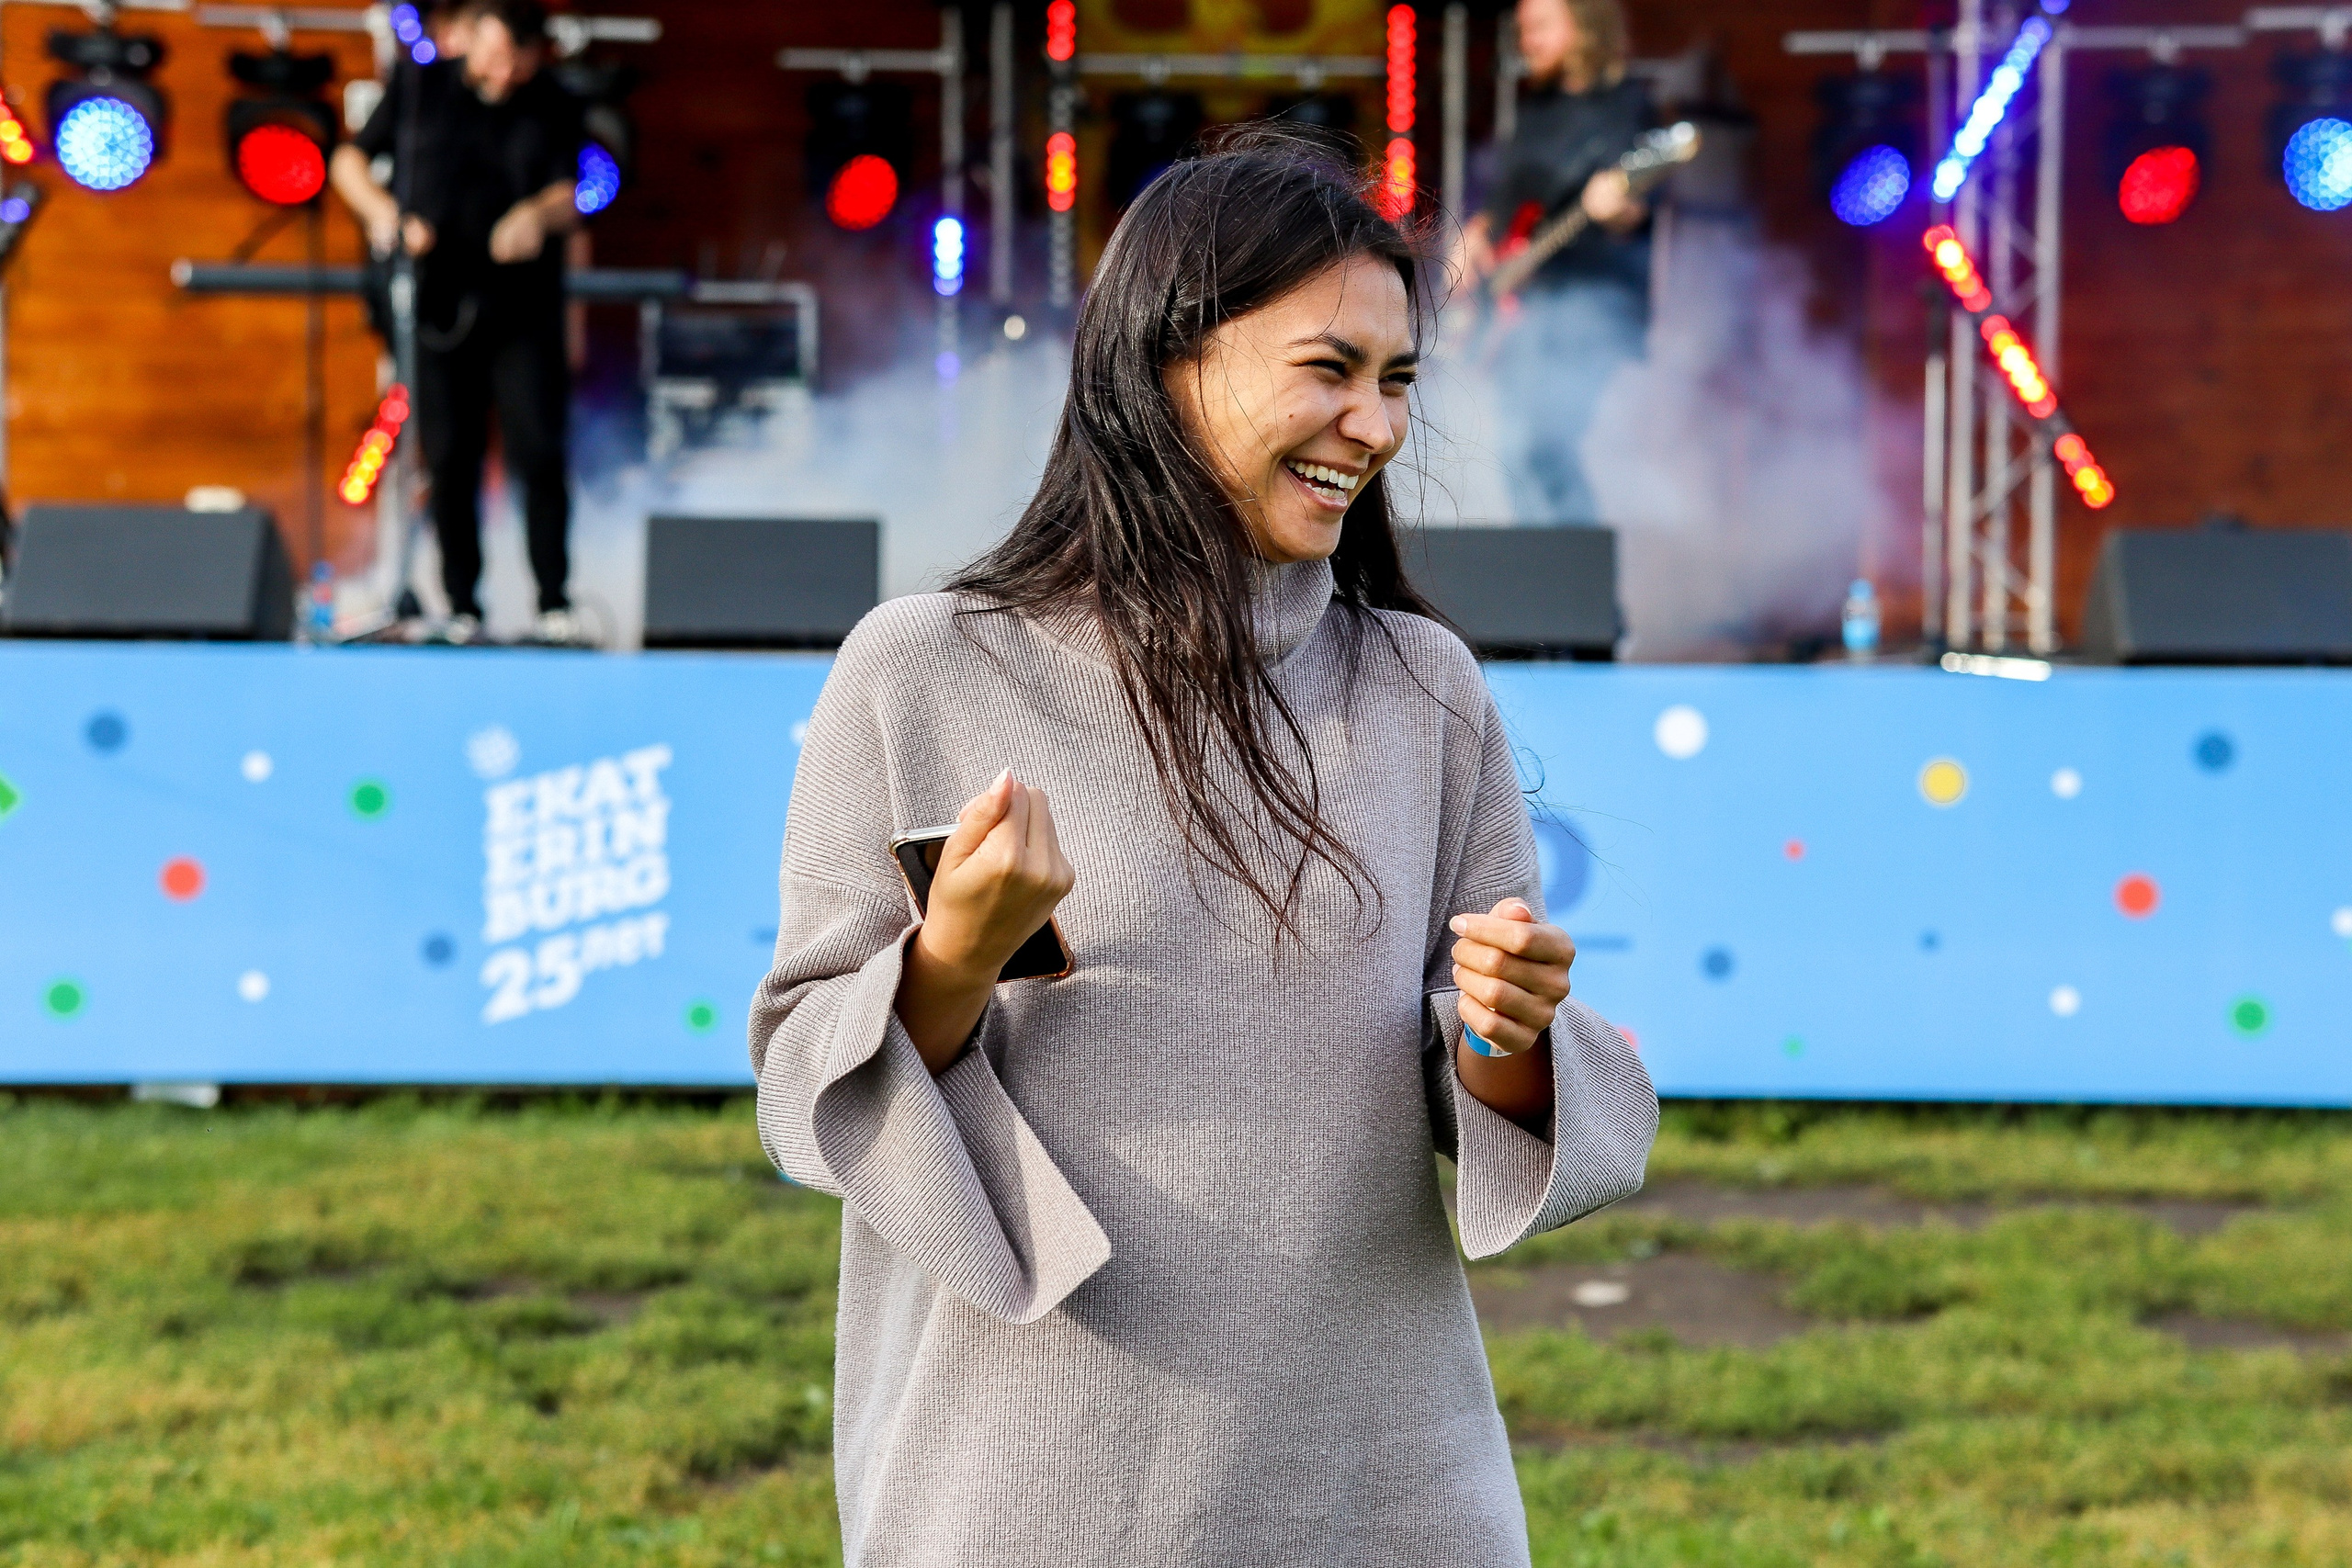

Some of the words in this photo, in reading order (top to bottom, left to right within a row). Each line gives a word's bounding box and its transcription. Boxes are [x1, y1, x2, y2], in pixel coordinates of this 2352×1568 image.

[485, 745, 672, 831] EKAT
[485, 798, 670, 883] ERIN
[482, 853, 670, 942] BURG
